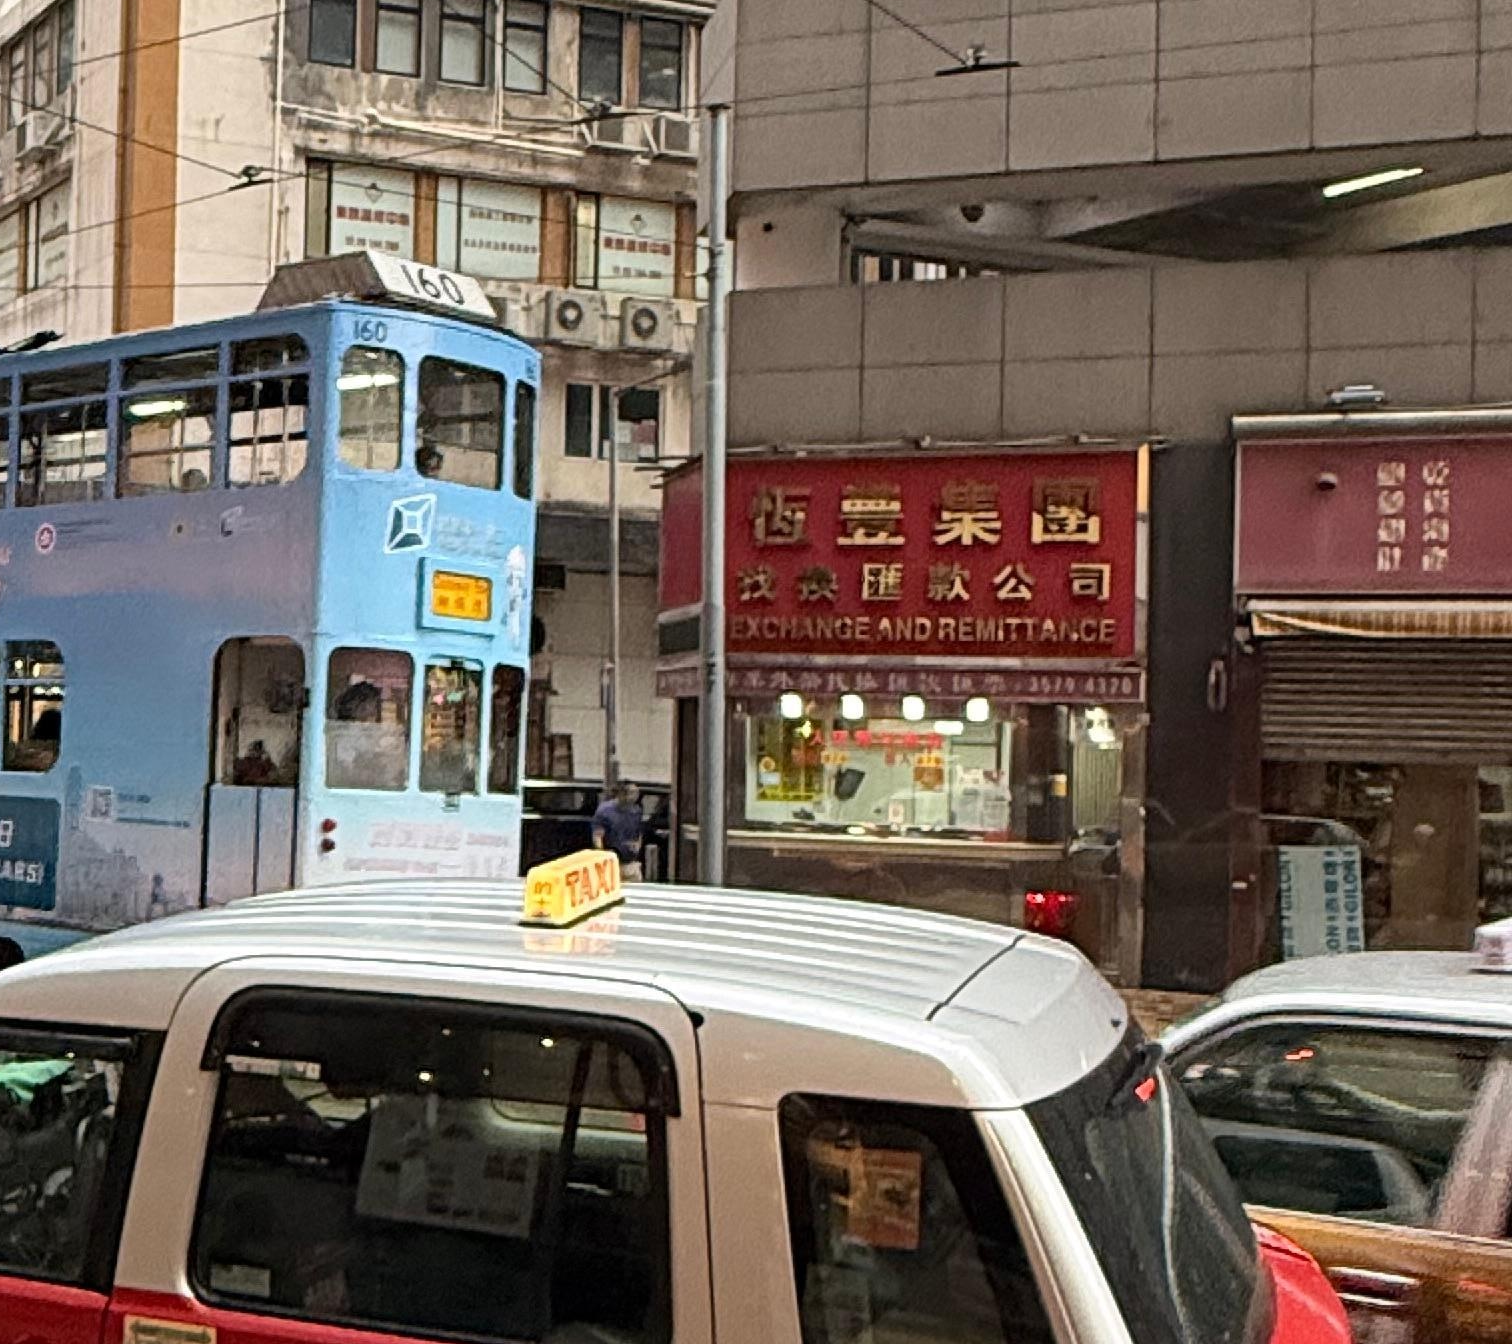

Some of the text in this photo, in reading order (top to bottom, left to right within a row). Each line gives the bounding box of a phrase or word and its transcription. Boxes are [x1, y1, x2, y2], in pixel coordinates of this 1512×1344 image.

[401, 264, 465, 306] 160
[353, 320, 388, 343] 160
[737, 562, 1112, 602] 找換匯款公司
[730, 616, 1117, 643] EXCHANGE AND REMITTANCE
[565, 859, 615, 908] TAXI
